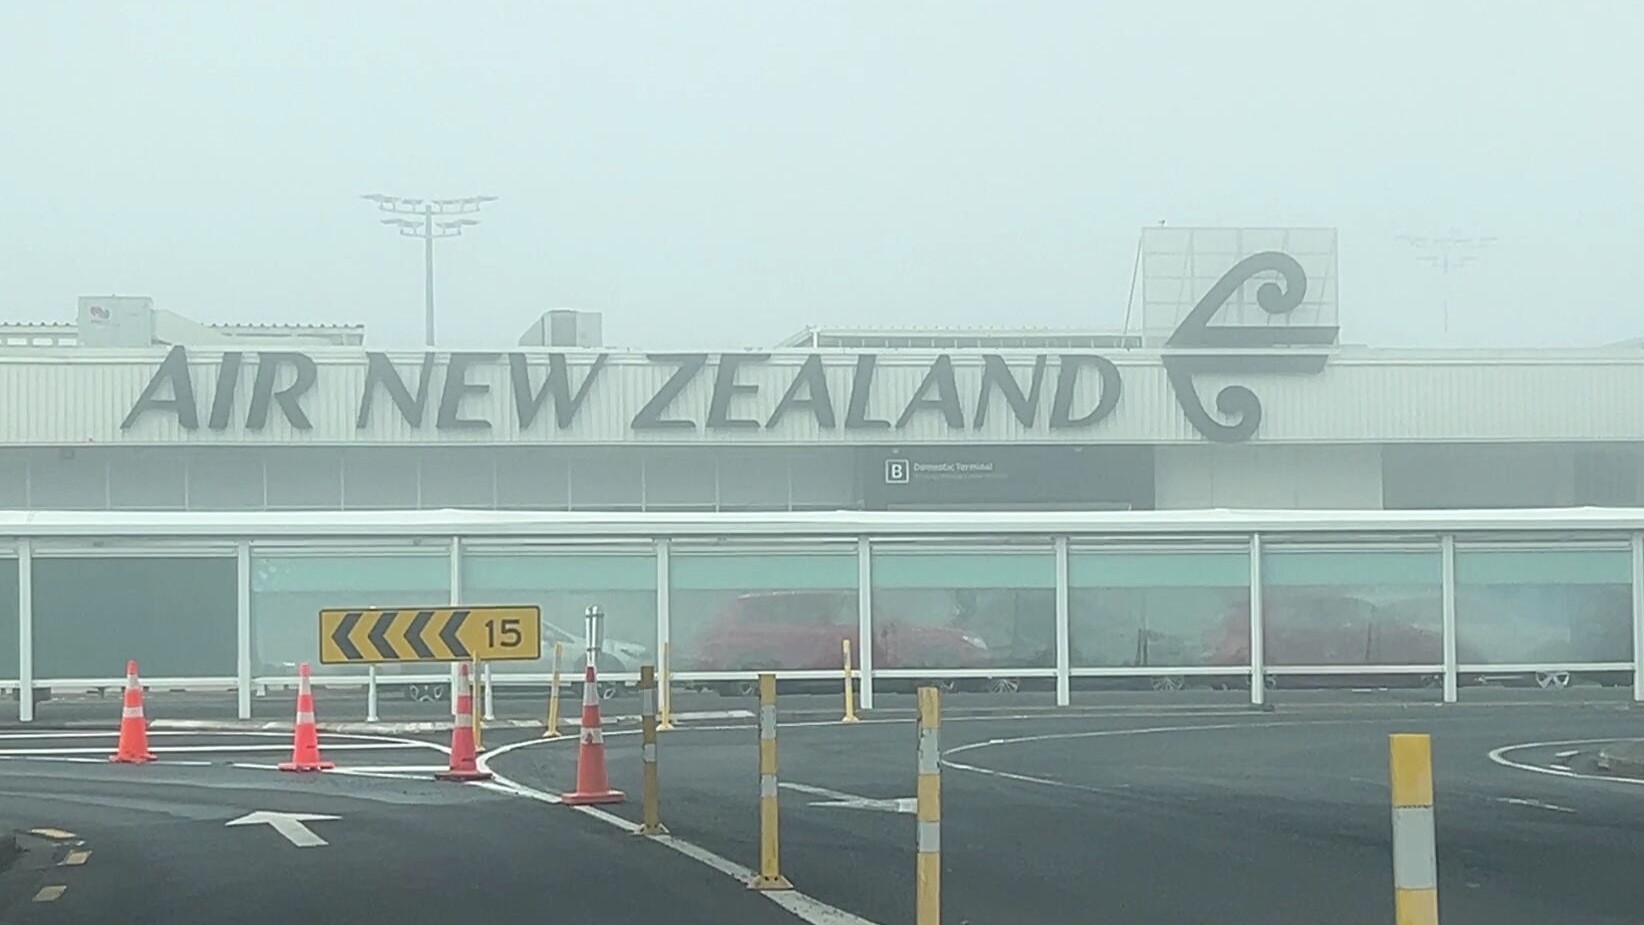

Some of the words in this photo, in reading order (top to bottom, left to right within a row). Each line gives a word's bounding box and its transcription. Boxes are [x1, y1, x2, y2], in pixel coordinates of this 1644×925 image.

[120, 345, 317, 429] AIR
[356, 351, 608, 429] NEW
[630, 353, 1122, 429] ZEALAND
[890, 463, 903, 479] B
[913, 462, 954, 472] Domestic
[956, 462, 993, 471] Terminal
[484, 618, 522, 649] 15
